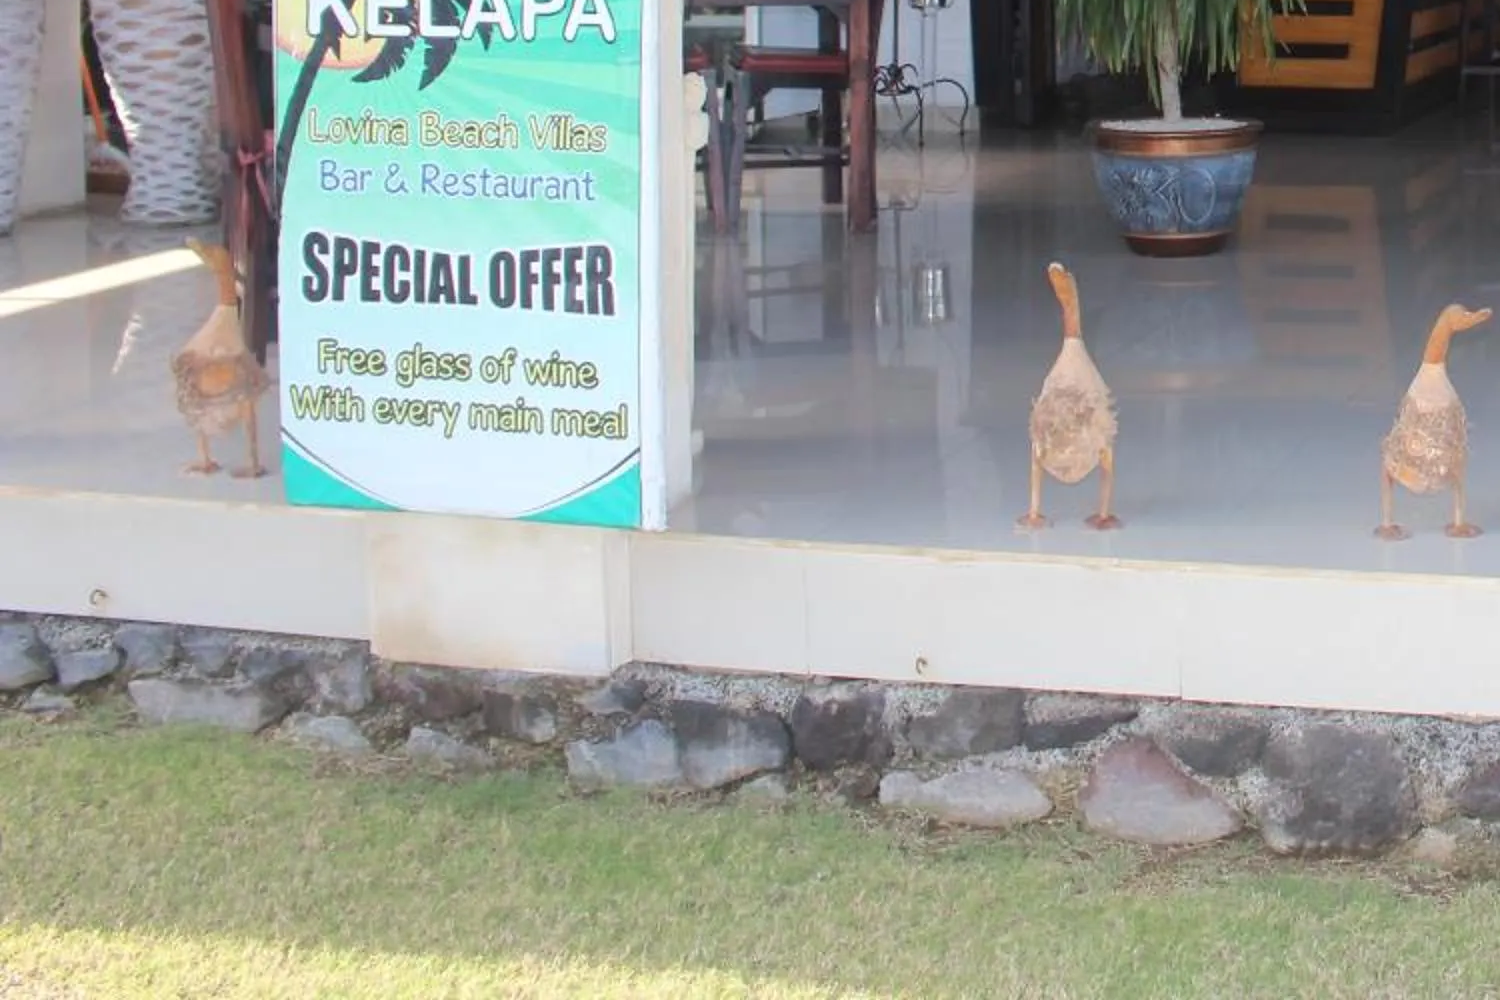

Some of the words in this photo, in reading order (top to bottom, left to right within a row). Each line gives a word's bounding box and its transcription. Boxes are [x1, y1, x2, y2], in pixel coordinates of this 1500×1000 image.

[307, 108, 408, 145] Lovina
[420, 110, 518, 148] Beach
[529, 114, 607, 152] Villas
[320, 160, 371, 192] Bar
[384, 163, 408, 193] &
[421, 164, 595, 200] Restaurant
[302, 231, 478, 305] SPECIAL
[489, 245, 615, 316] OFFER
[317, 338, 387, 374] Free
[396, 343, 472, 387] glass
[480, 348, 516, 383] of
[523, 351, 599, 388] wine
[290, 384, 365, 422] With
[372, 397, 460, 438] every
[468, 397, 544, 434] main
[552, 403, 628, 439] meal
